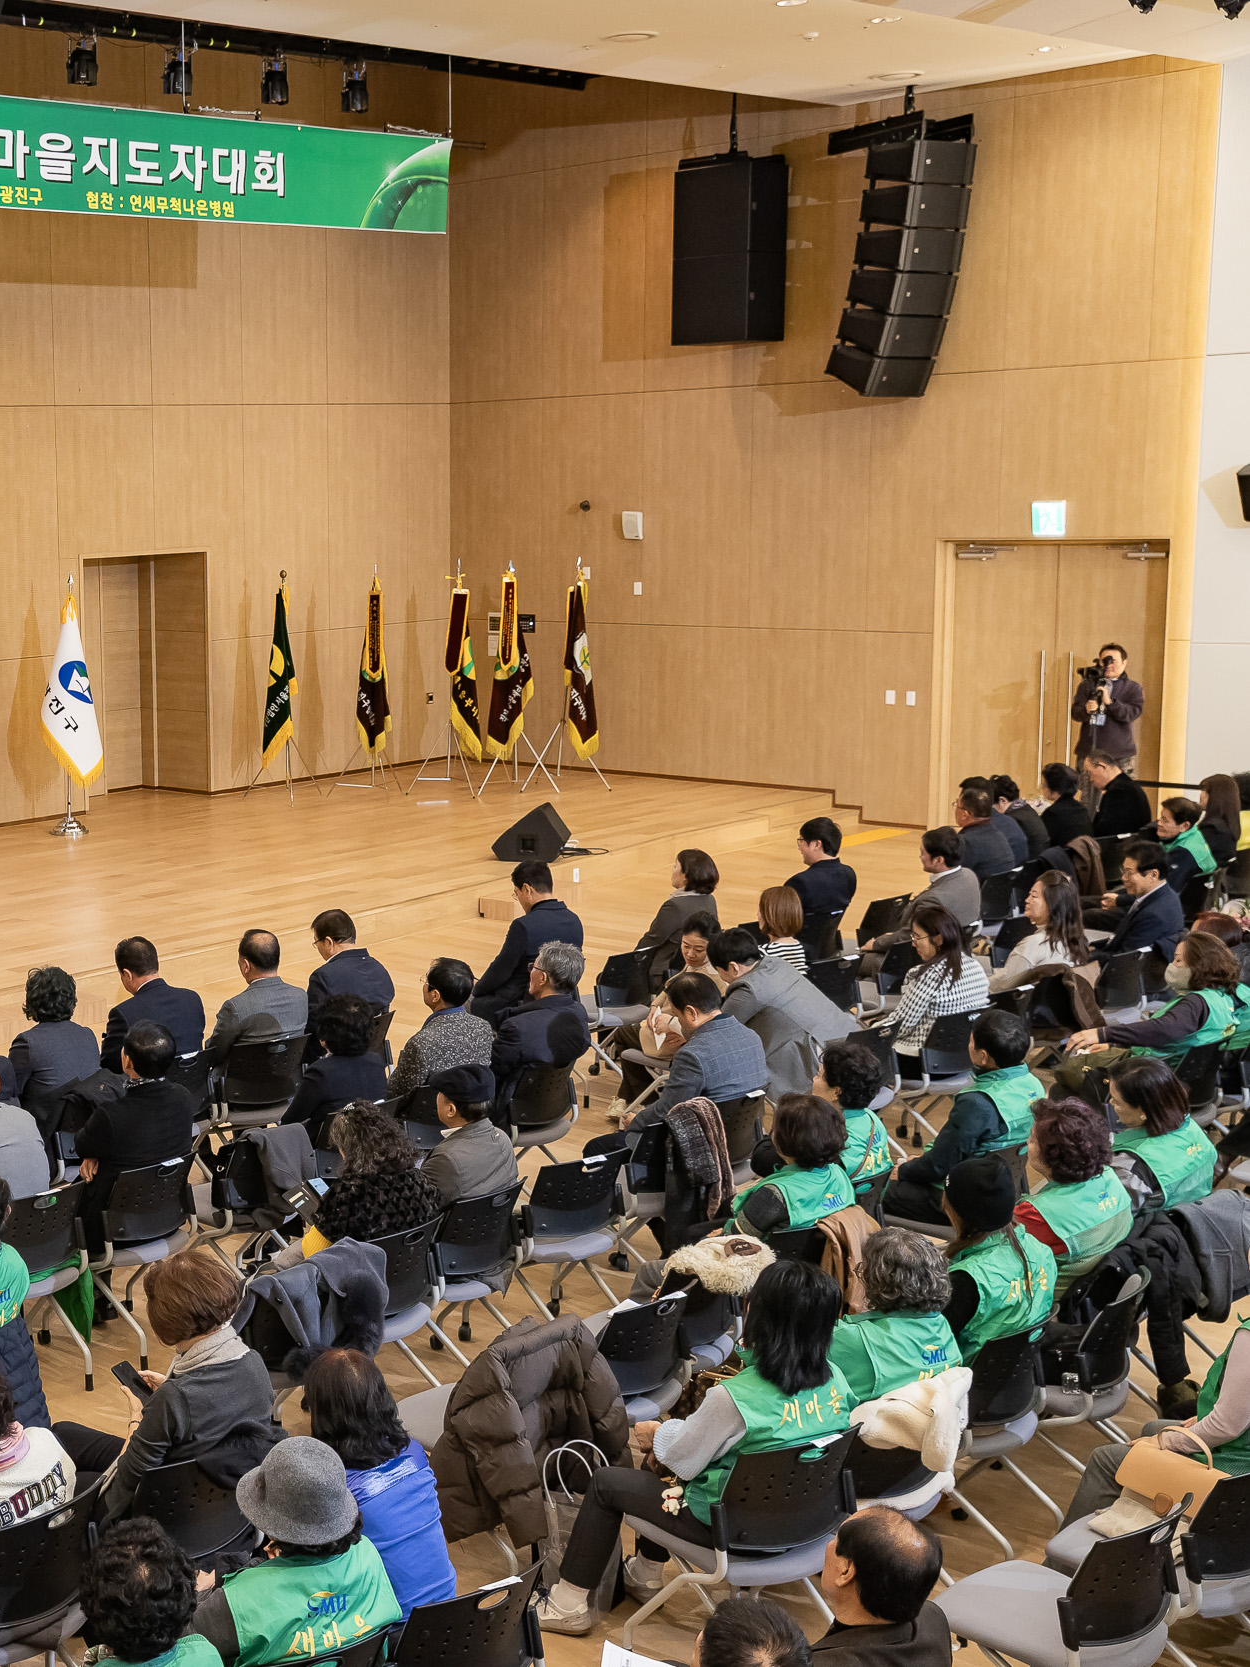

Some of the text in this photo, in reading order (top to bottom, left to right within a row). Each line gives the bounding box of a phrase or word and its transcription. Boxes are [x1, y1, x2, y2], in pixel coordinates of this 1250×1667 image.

[0, 184, 43, 206] 광진구
[85, 190, 114, 210] 협찬
[129, 192, 236, 218] 연세무척나은병원
[45, 682, 79, 733] 진구
[821, 1193, 846, 1211] SMU
[1006, 1265, 1049, 1303] 새마을
[921, 1347, 948, 1366] SMU
[779, 1385, 844, 1429] 새마을
[307, 1592, 347, 1618] SMU
